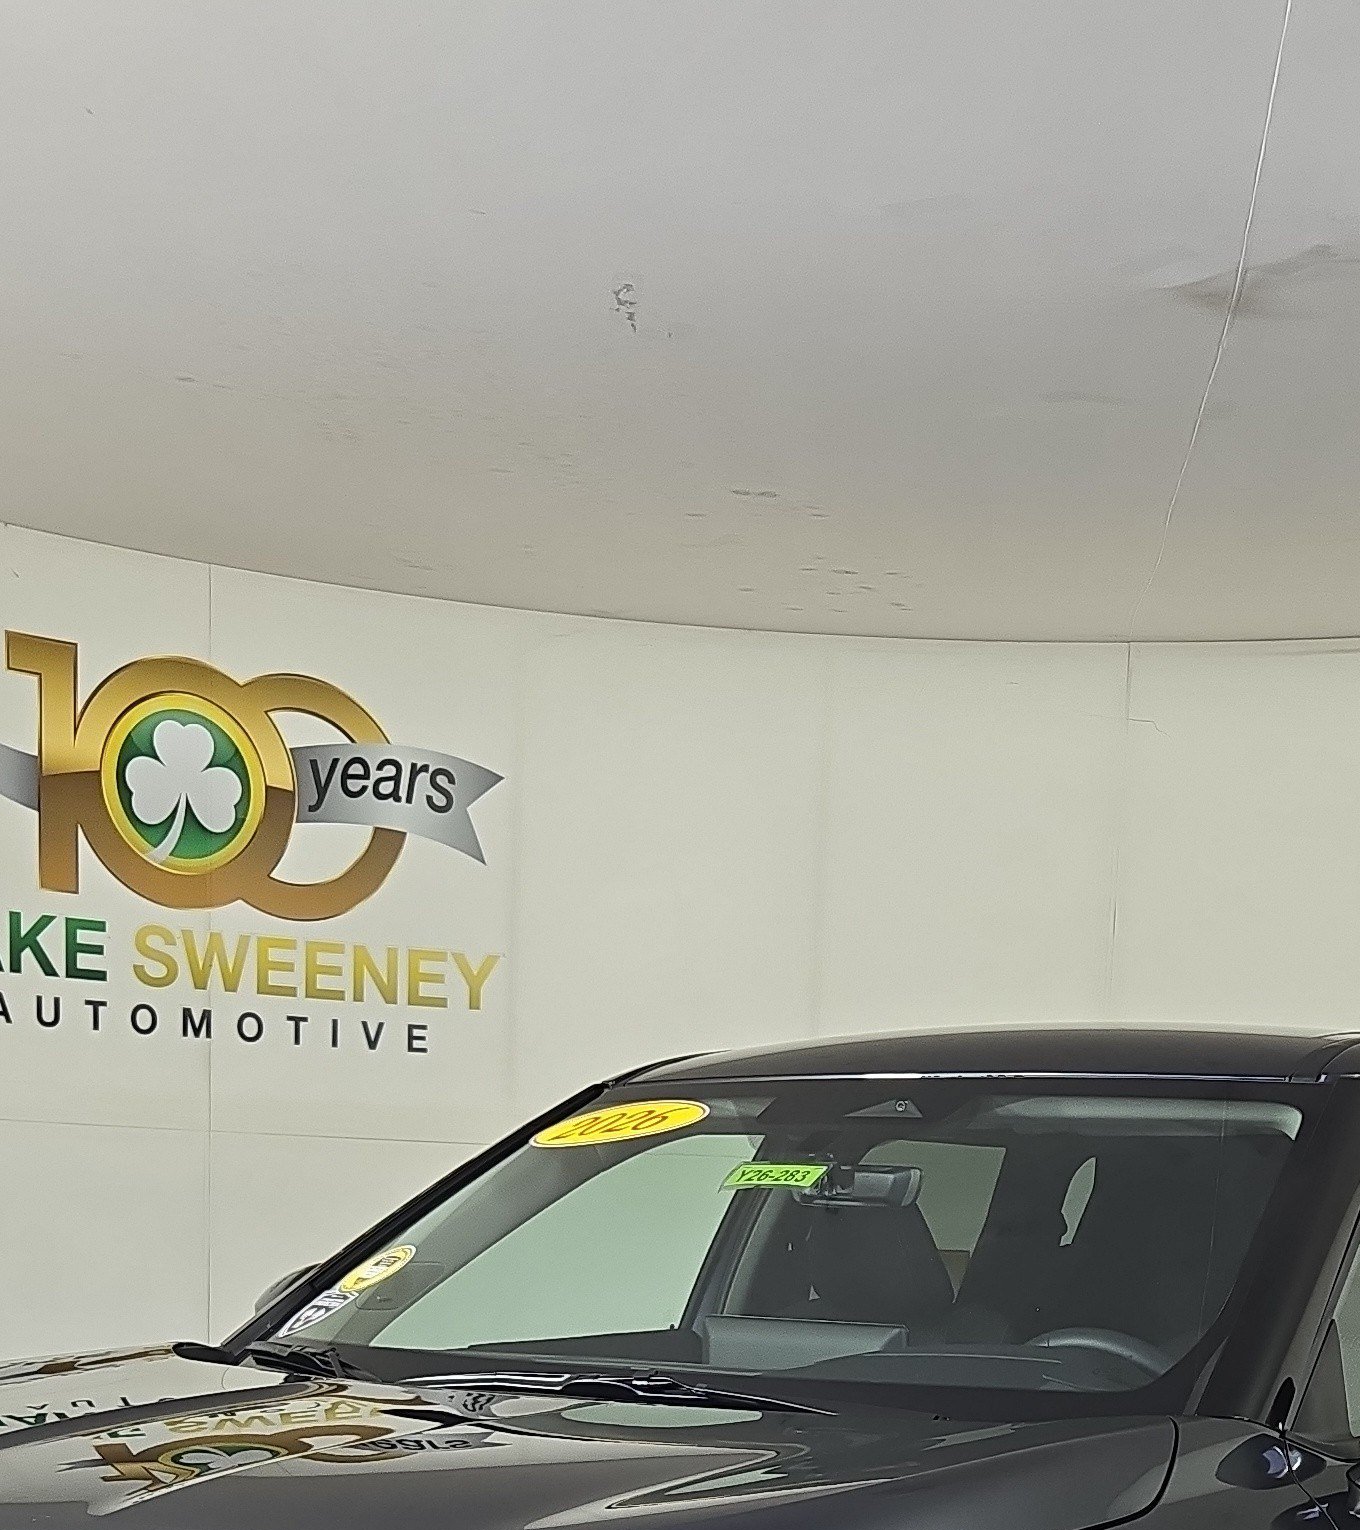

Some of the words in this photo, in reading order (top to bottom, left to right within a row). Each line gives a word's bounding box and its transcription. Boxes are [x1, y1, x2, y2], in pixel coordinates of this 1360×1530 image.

[4, 630, 408, 921] 100
[308, 757, 456, 813] years
[132, 924, 500, 1011] SWEENEY
[546, 1107, 690, 1141] 2026
[735, 1168, 811, 1184] Y26-283
